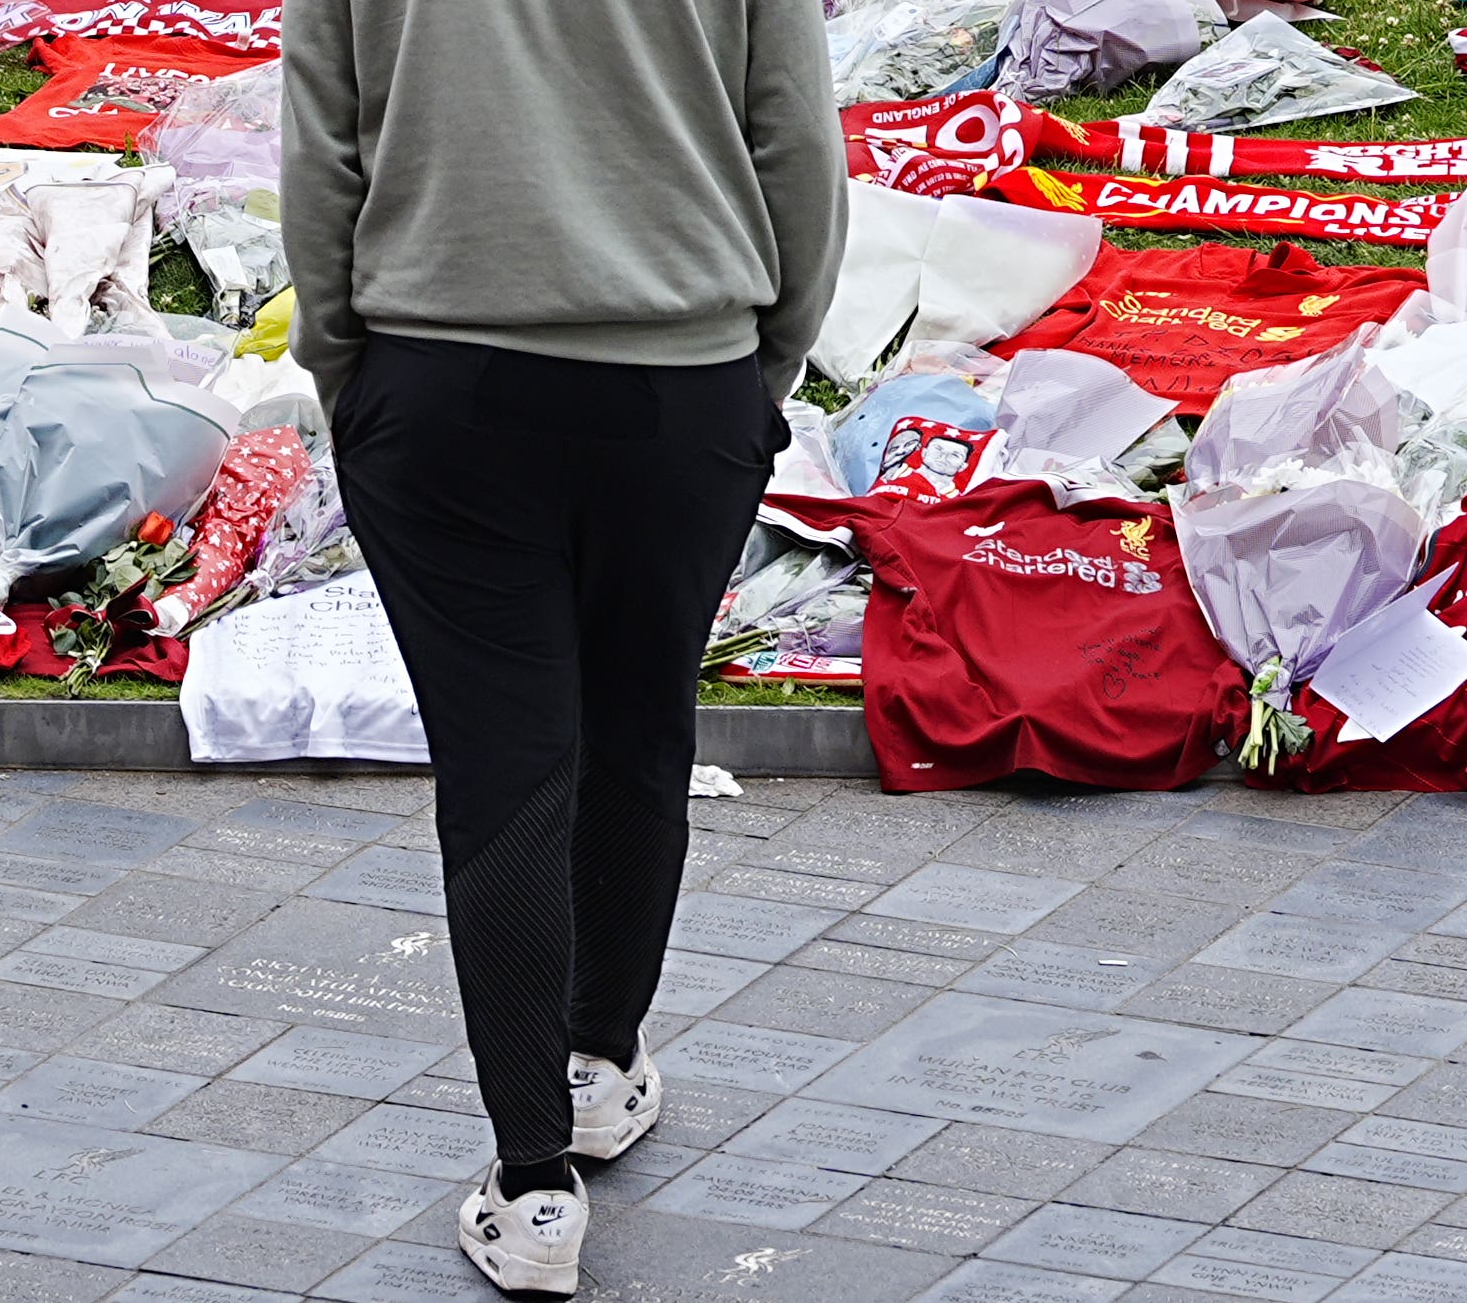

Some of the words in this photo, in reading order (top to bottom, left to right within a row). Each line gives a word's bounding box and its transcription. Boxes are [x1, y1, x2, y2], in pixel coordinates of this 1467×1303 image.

[1098, 180, 1423, 229] CHAMPIONS
[972, 537, 1117, 570] Standard
[961, 547, 1120, 588] Chartered
[573, 1068, 600, 1084] NIKE
[538, 1204, 564, 1219] NIKE
[537, 1227, 562, 1238] AIR
